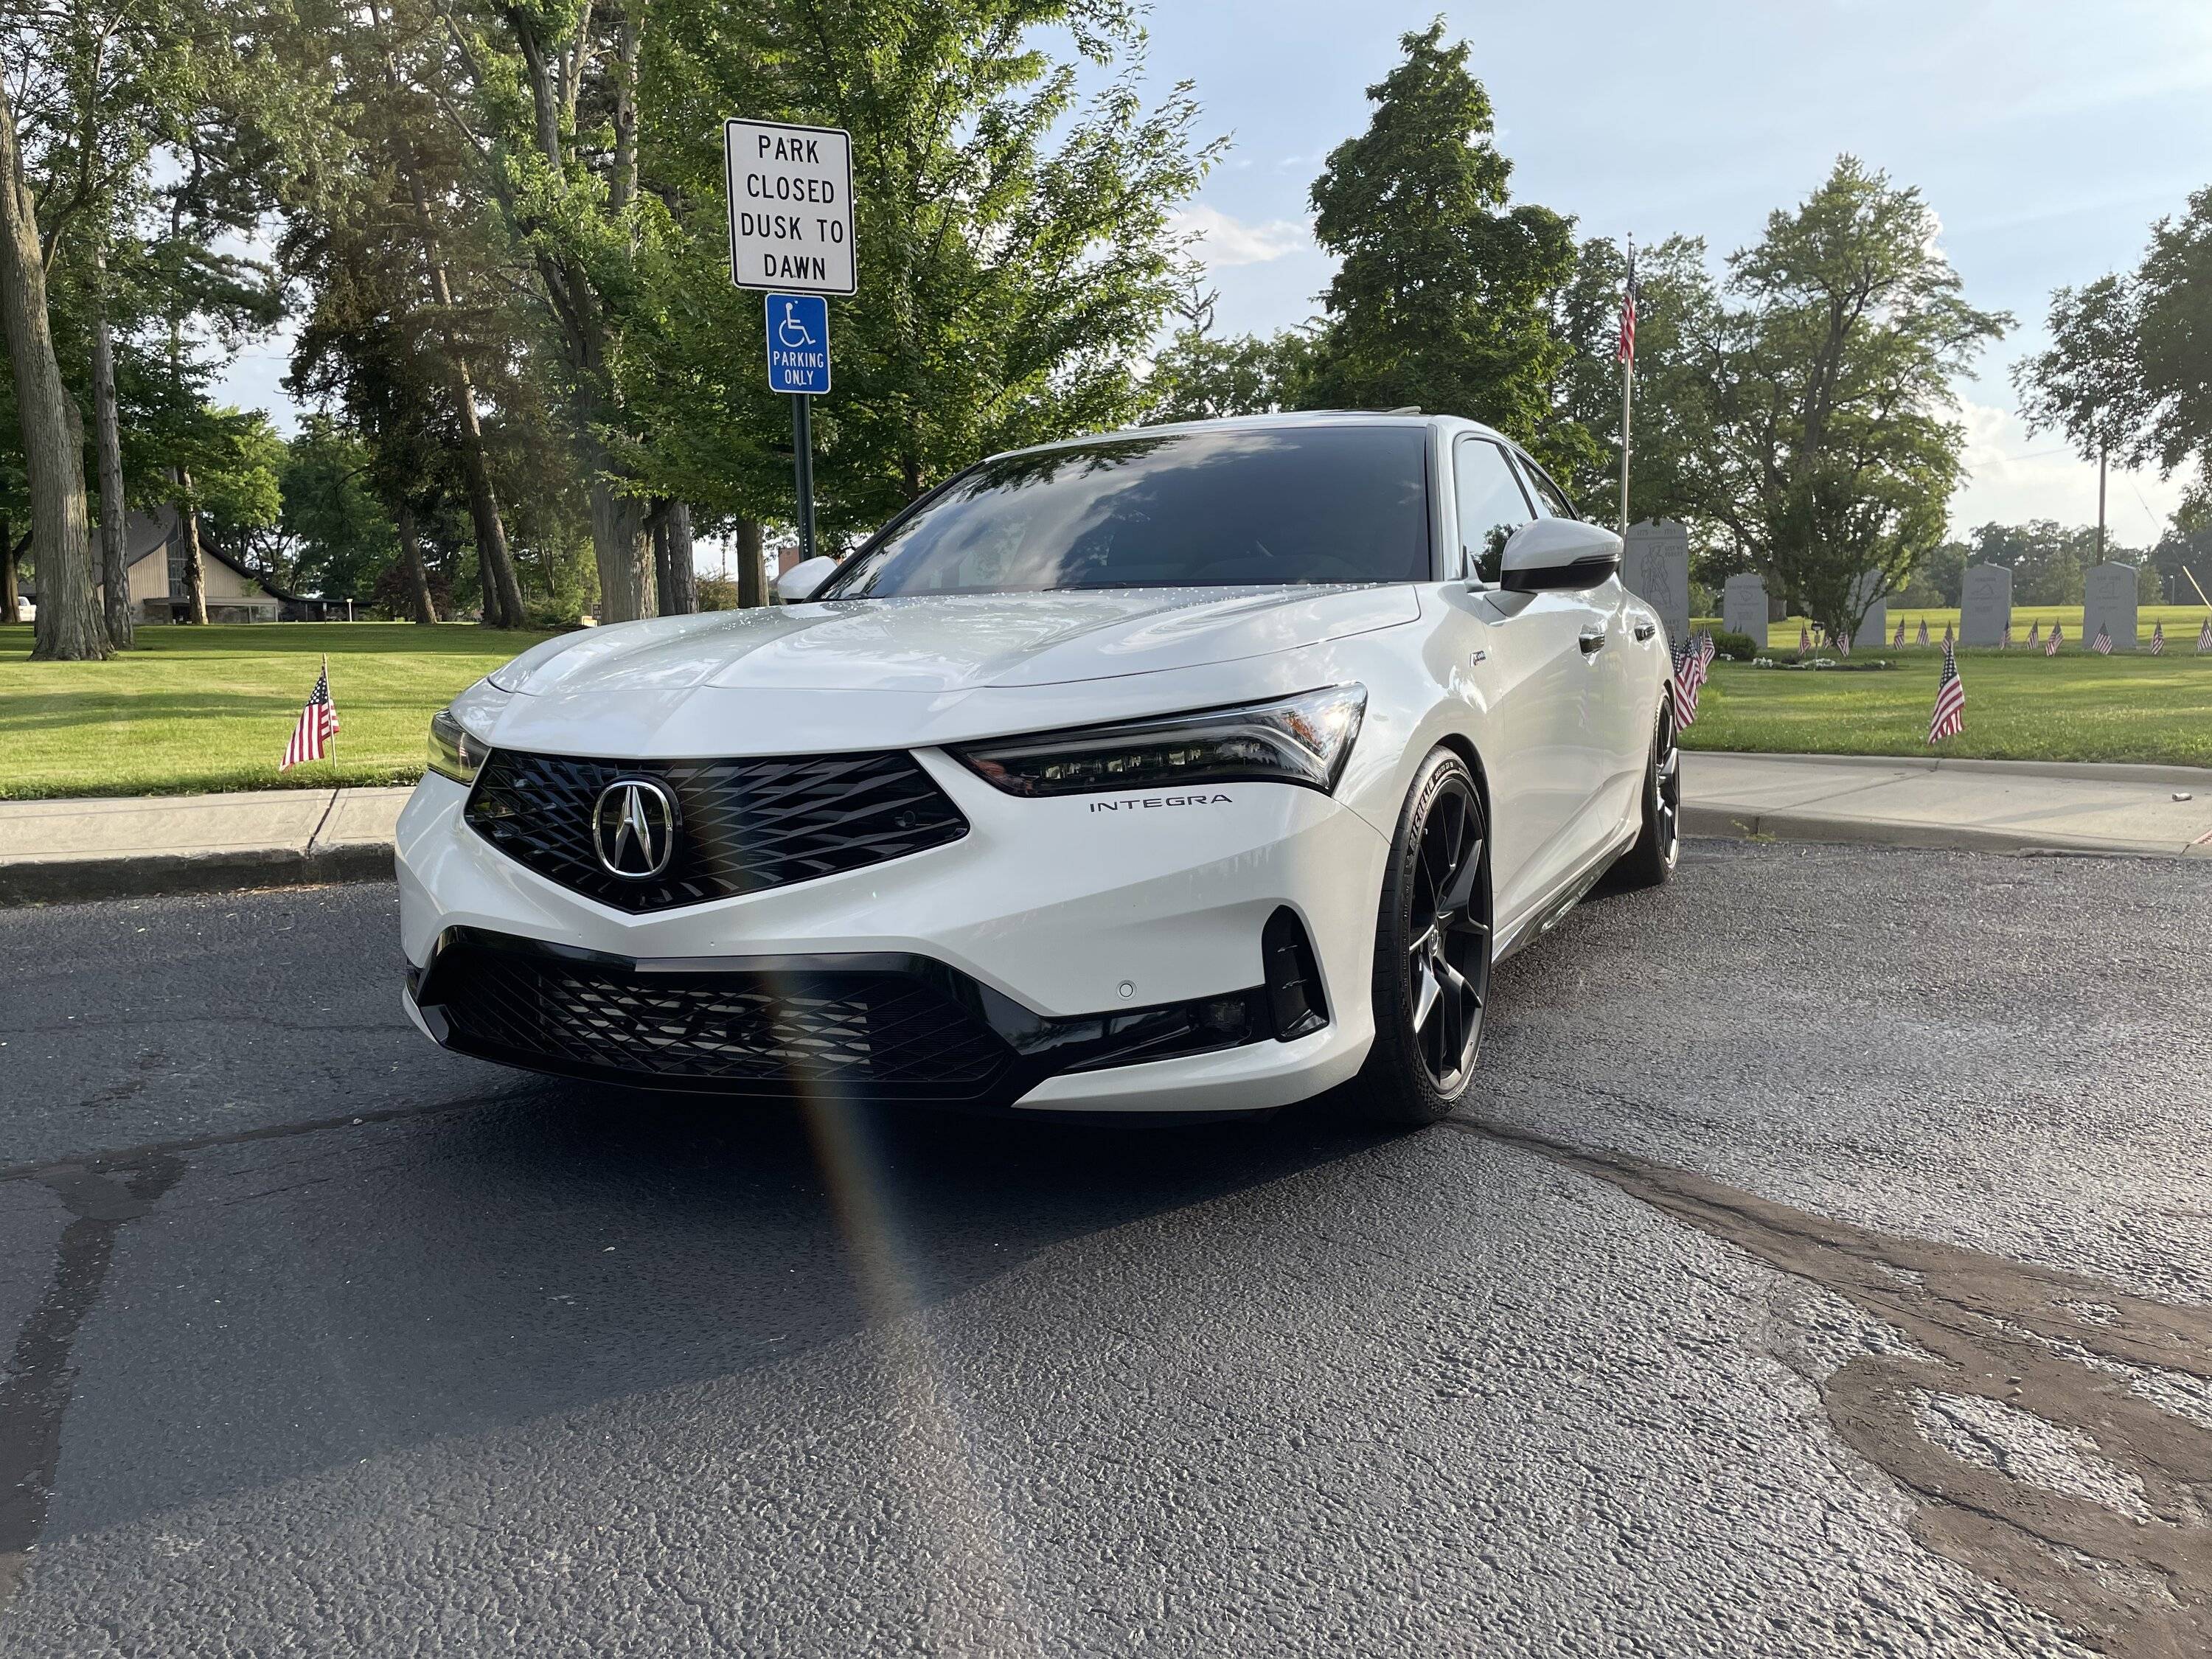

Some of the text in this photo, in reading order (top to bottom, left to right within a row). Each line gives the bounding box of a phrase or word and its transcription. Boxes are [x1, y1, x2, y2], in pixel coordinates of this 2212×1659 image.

[758, 134, 820, 164] PARK
[747, 173, 835, 204] CLOSED
[741, 212, 844, 243] DUSK TO
[764, 254, 826, 281] DAWN
[773, 350, 824, 368] PARKING
[784, 369, 814, 386] ONLY
[1089, 794, 1233, 813] INTEGRA
[1409, 776, 1435, 852] MICHELIN
